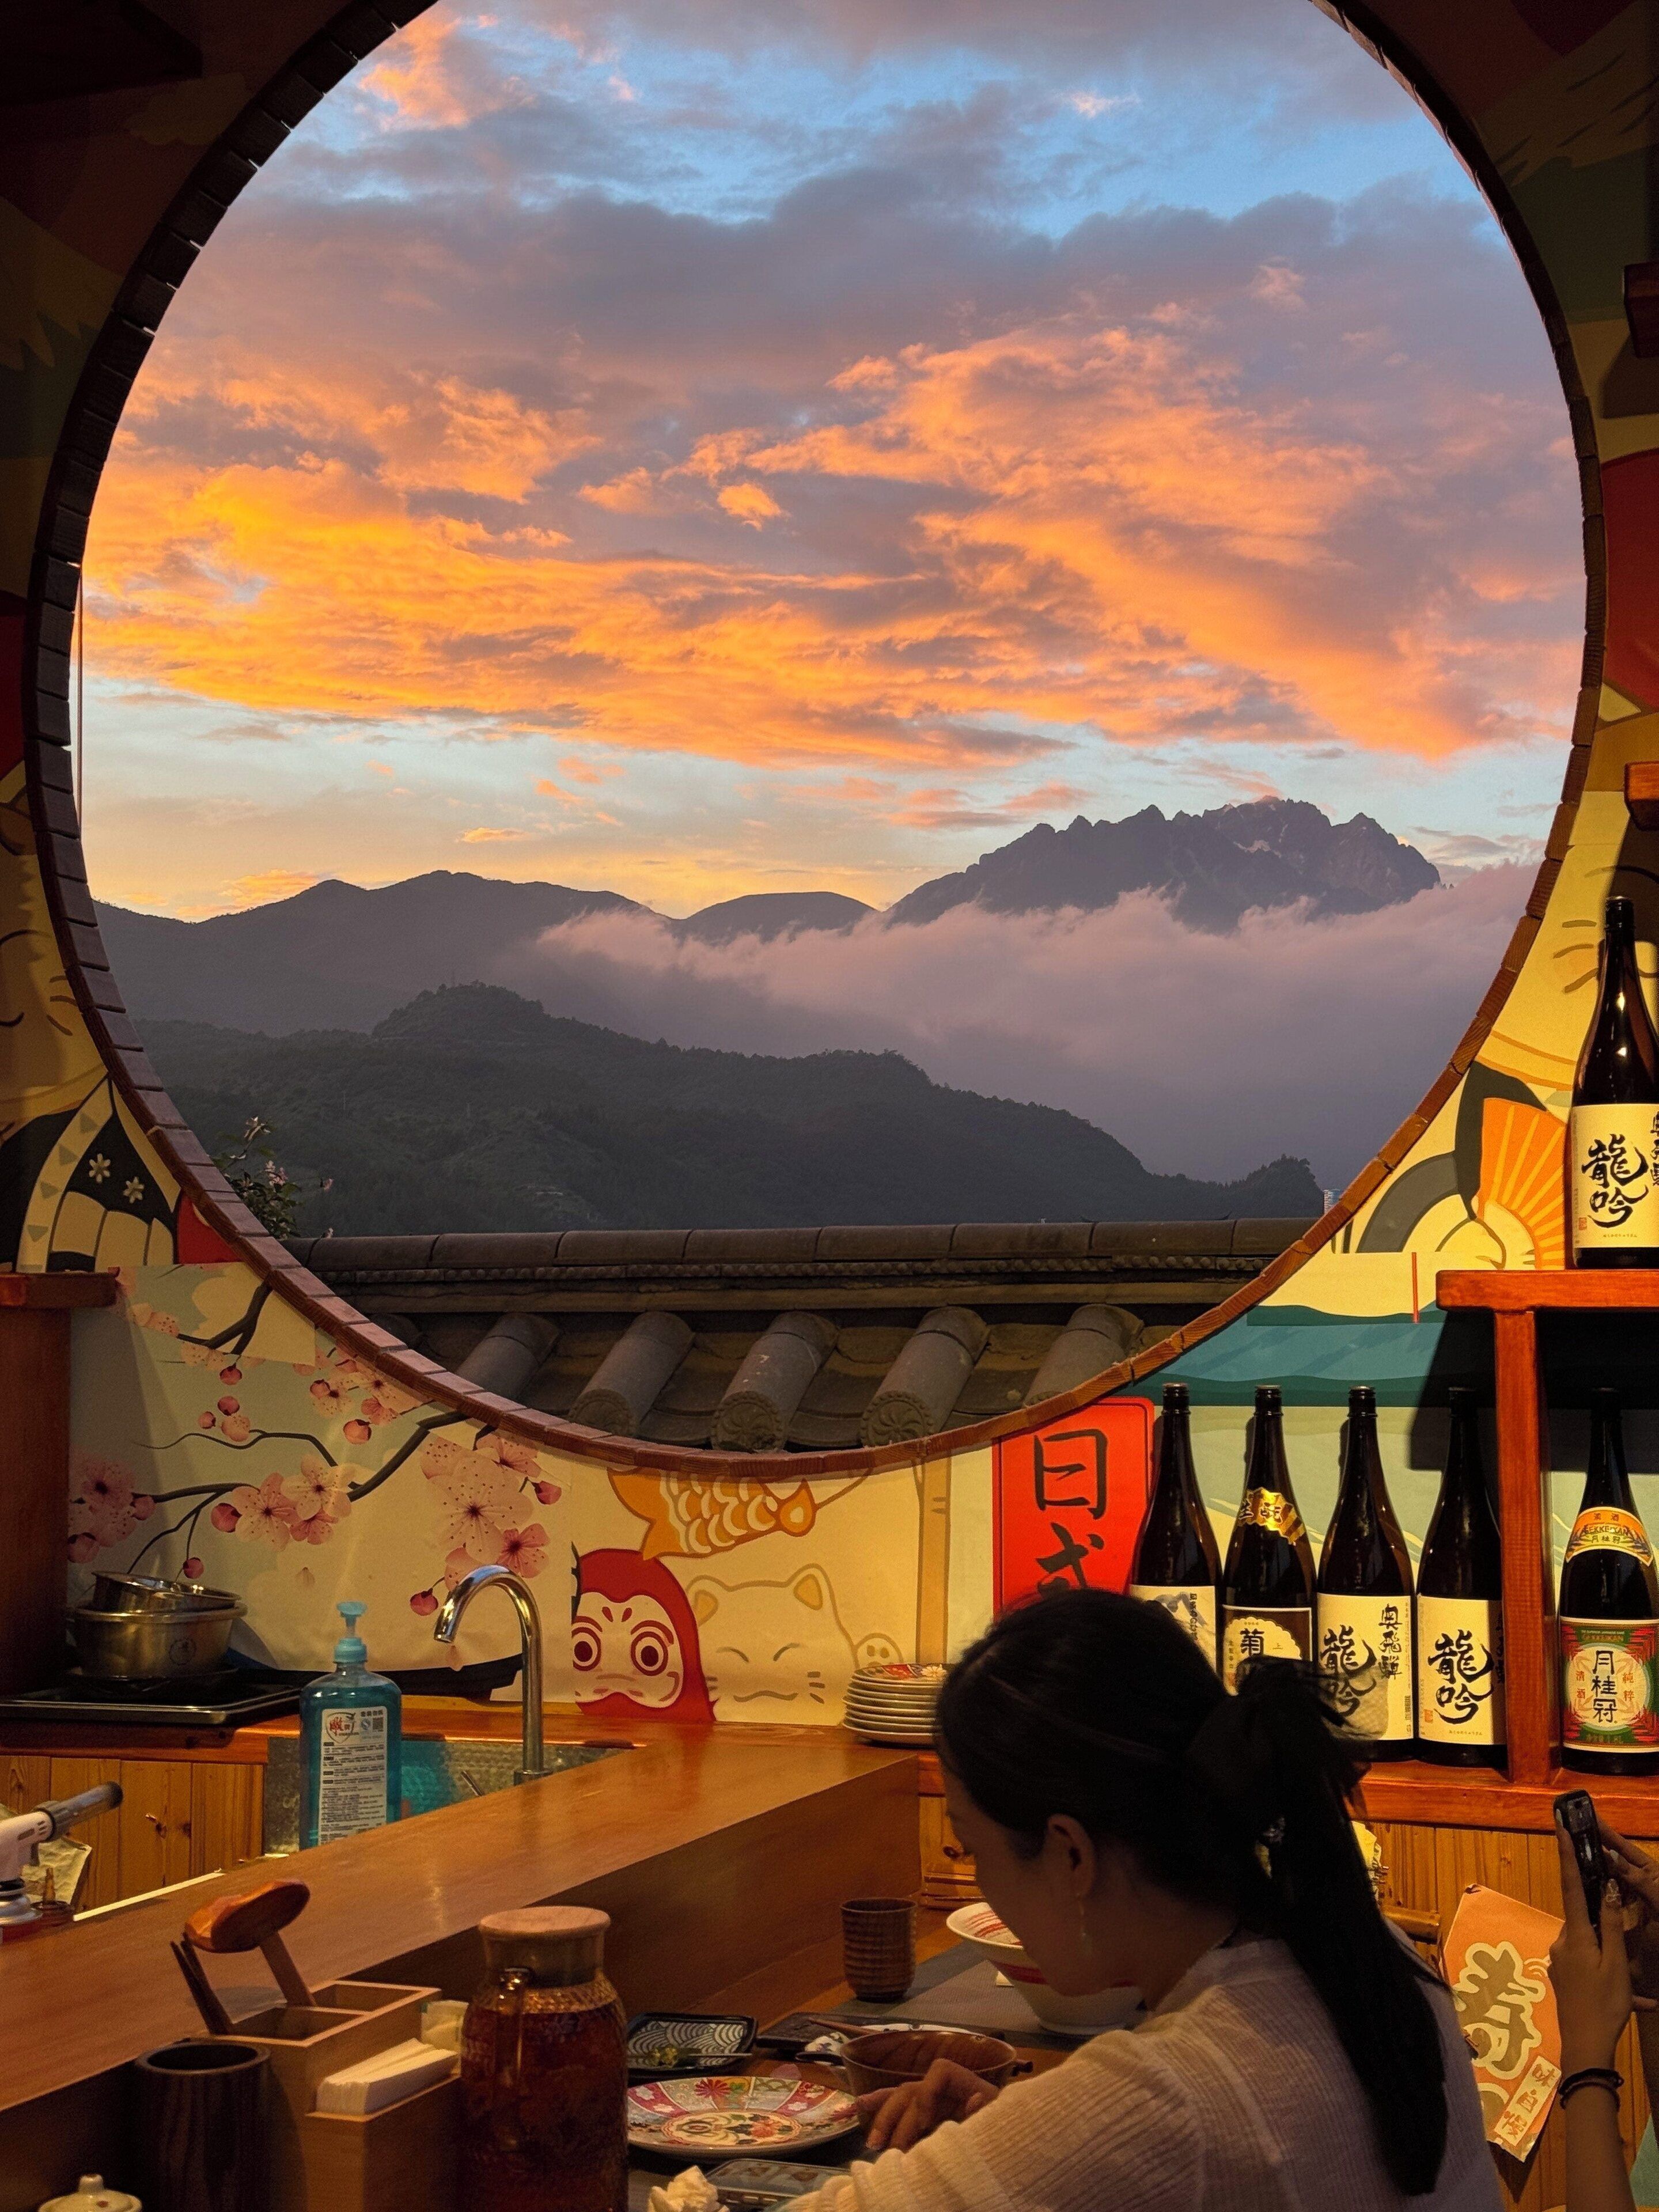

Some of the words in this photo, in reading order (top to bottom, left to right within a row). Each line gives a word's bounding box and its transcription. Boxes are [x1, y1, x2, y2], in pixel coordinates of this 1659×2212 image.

[1581, 1134, 1649, 1228] 龍吟
[1428, 1629, 1494, 1725] 龍吟
[1591, 1650, 1618, 1723] 月桂冠
[1502, 2063, 1556, 2140] 味自慢
